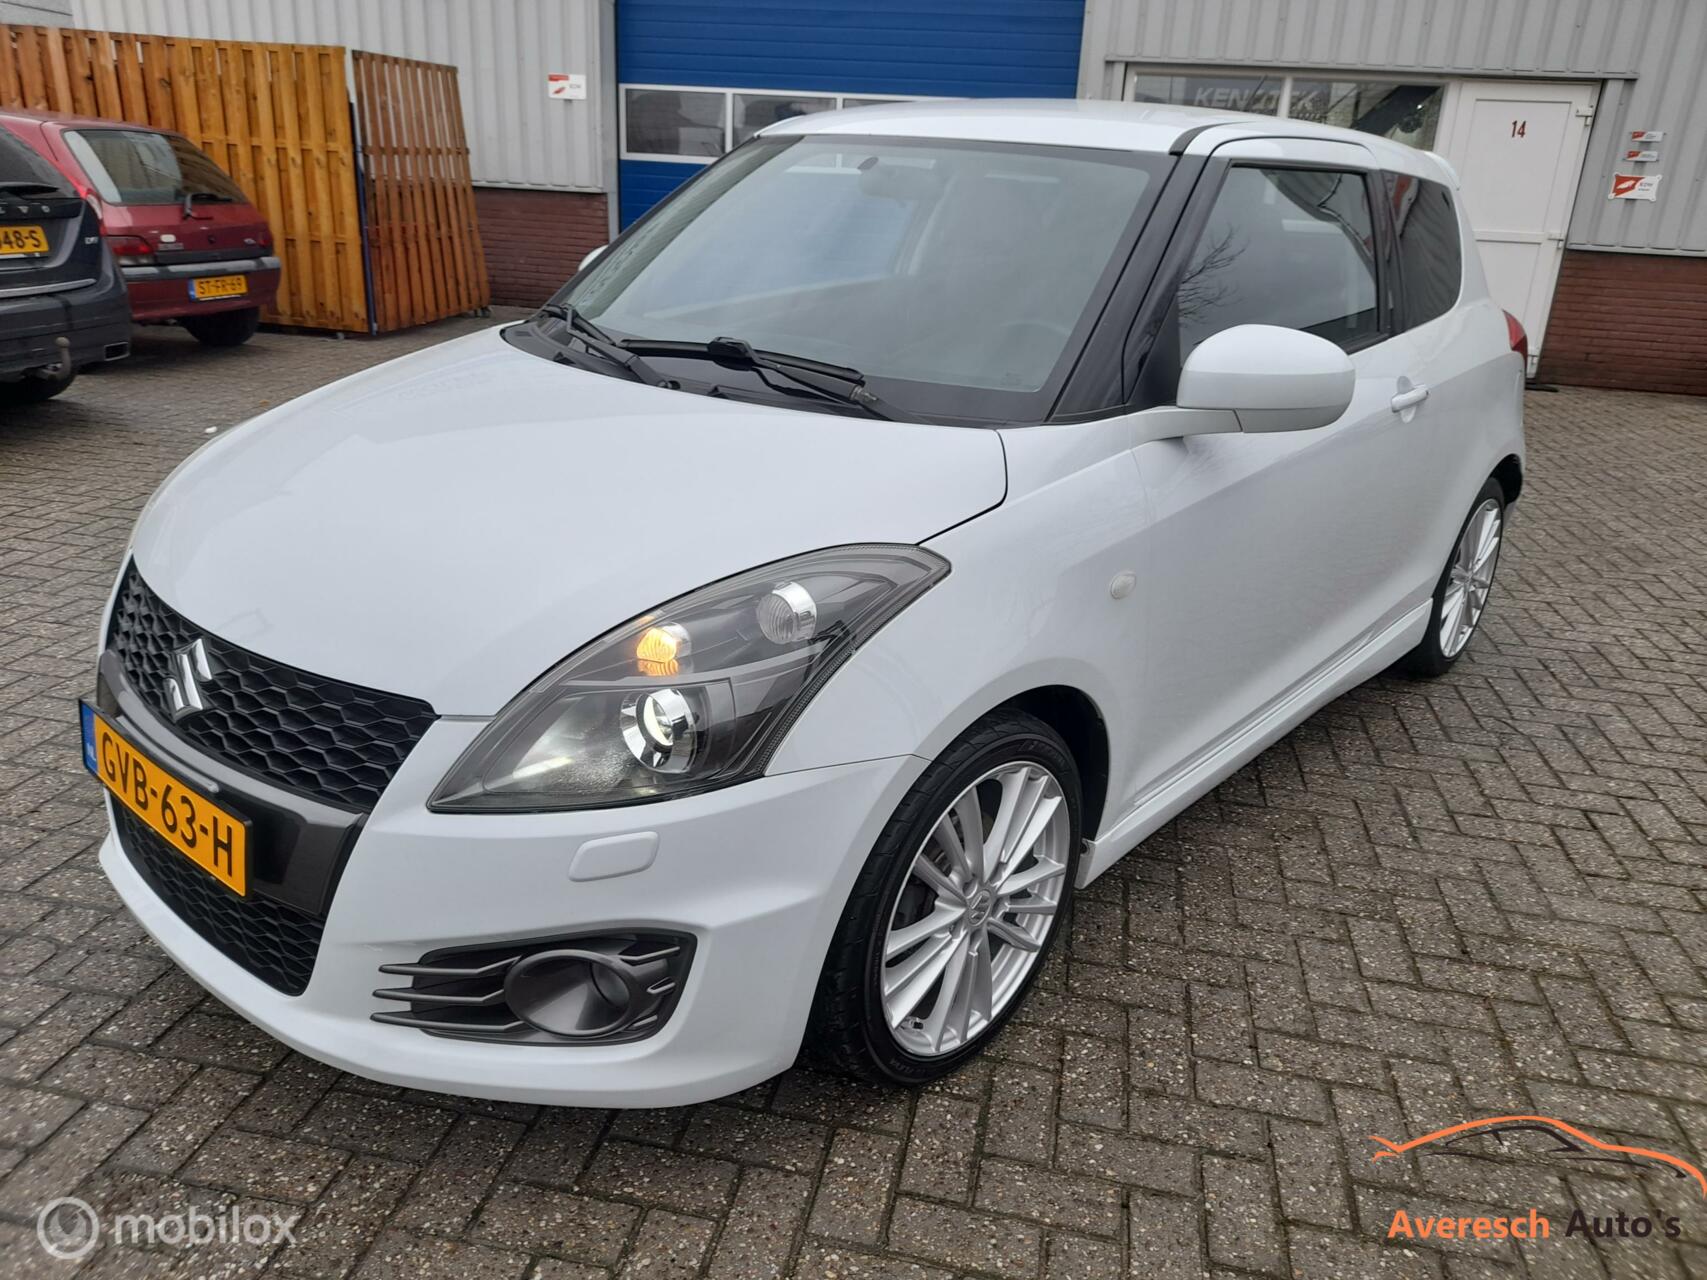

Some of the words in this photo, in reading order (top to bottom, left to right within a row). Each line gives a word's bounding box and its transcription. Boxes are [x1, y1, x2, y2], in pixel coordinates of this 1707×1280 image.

[1512, 120, 1526, 138] 14
[0, 230, 41, 249] 48-S
[102, 732, 232, 877] GVB-63-H
